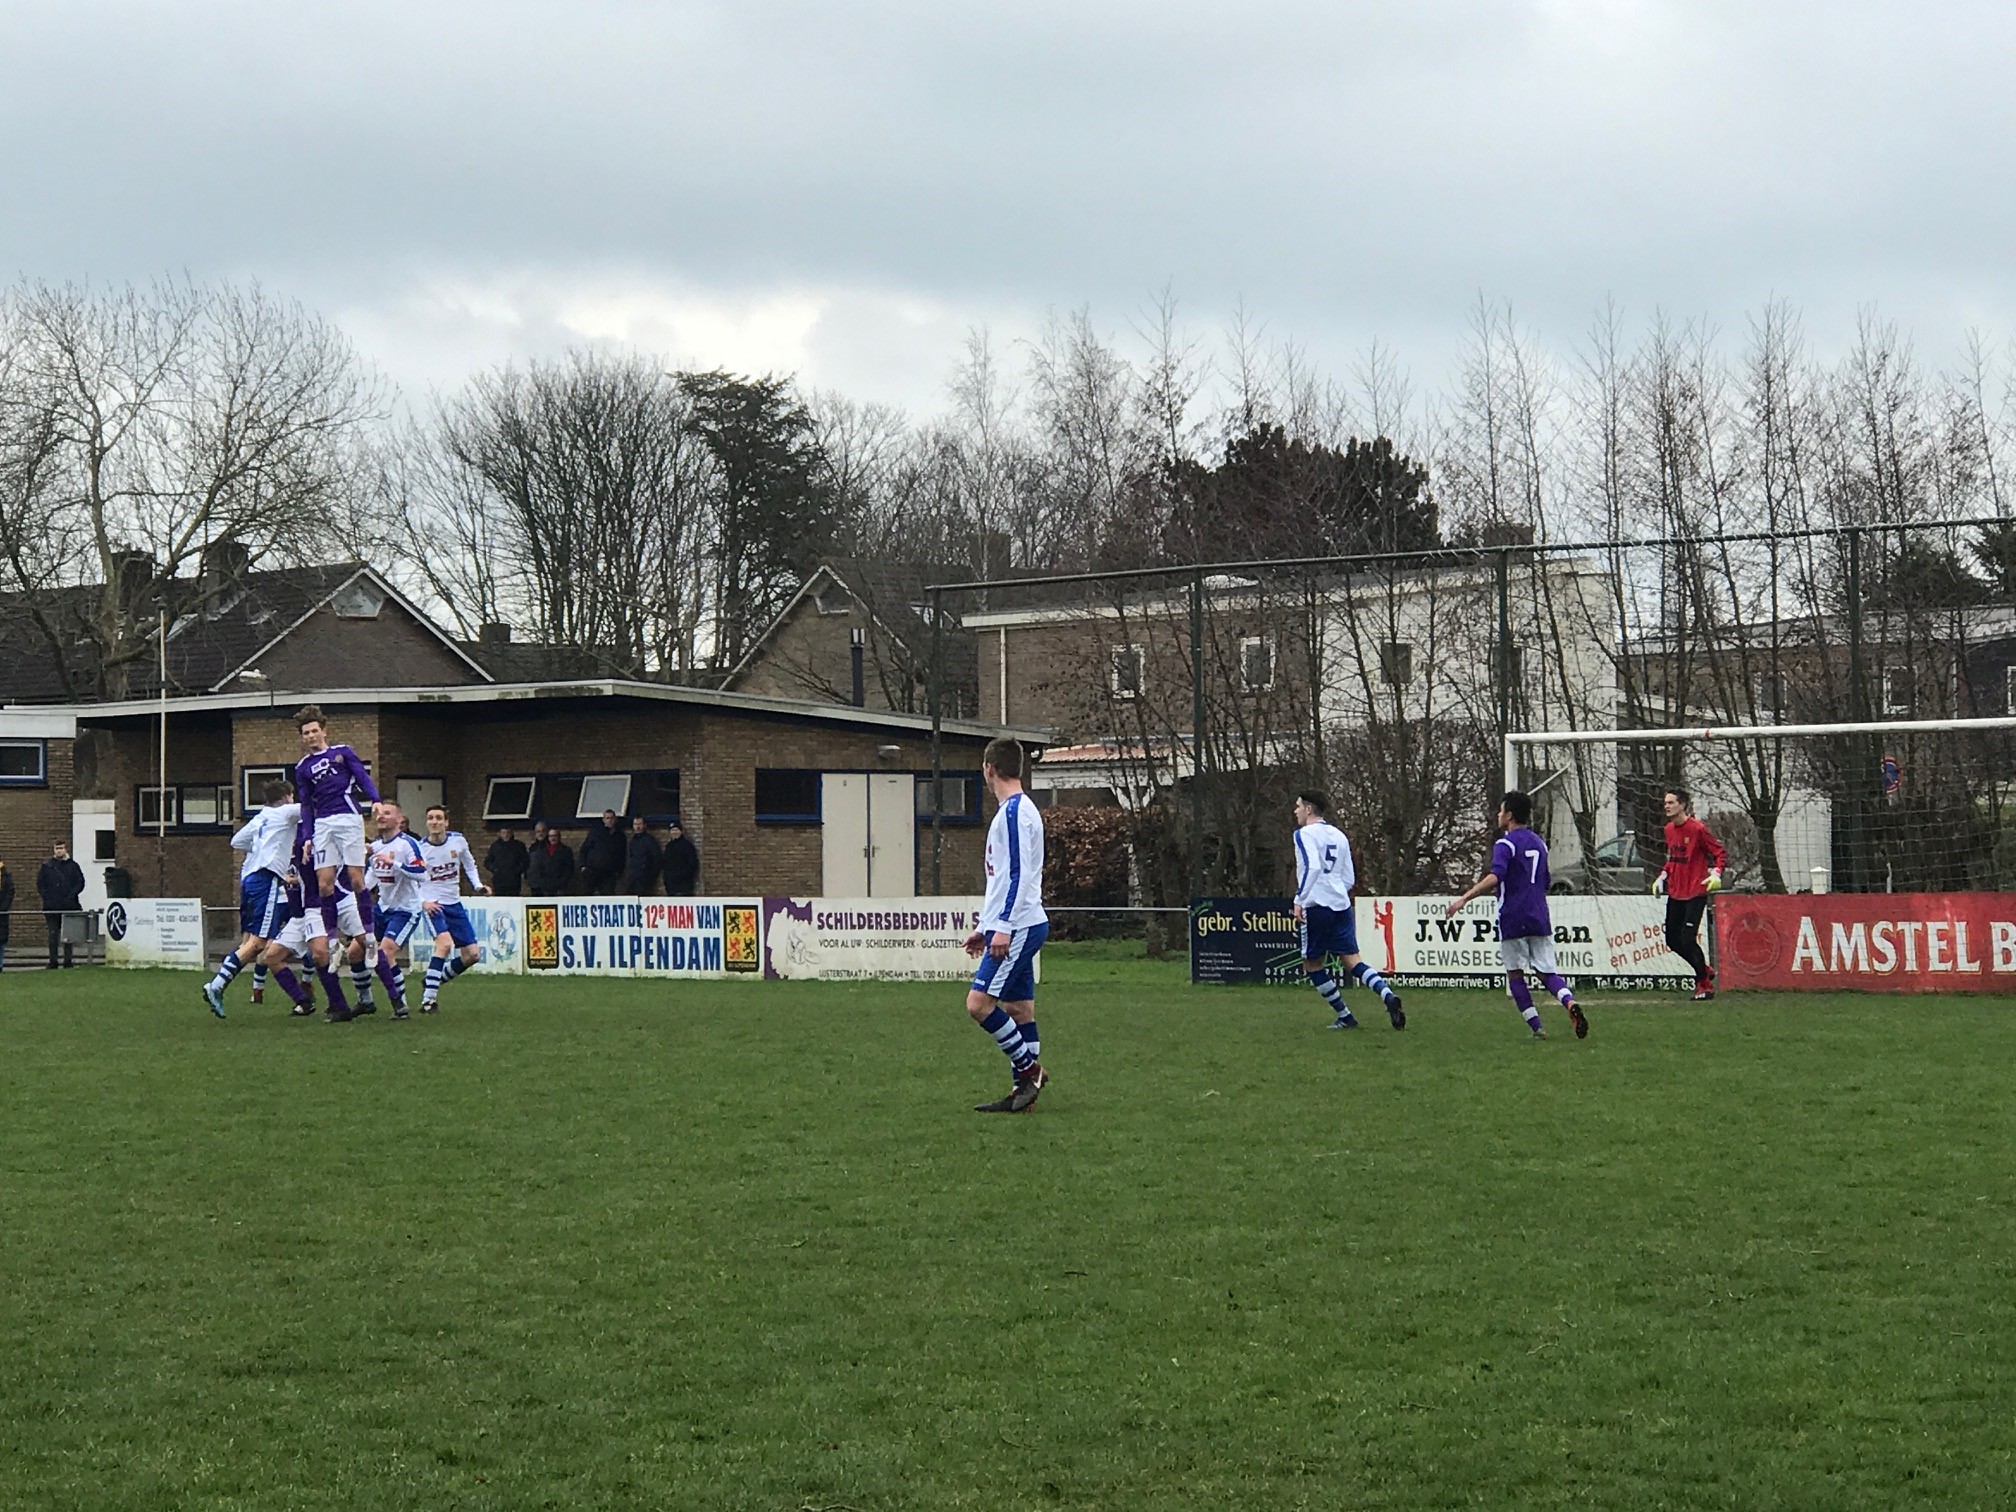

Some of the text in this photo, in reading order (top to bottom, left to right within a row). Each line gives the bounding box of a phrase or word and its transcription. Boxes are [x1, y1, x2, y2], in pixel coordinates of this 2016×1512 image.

[1323, 844, 1338, 874] 5
[1524, 849, 1540, 884] 7
[562, 904, 588, 928] HIER
[590, 904, 625, 928] STAAT
[627, 904, 643, 928] DE
[667, 905, 694, 929] MAN
[696, 905, 720, 929] VAN
[1417, 901, 1496, 918] loonedrijf
[817, 911, 947, 931] SCHILDERSBEDRIJF
[1198, 911, 1237, 937] gebr.
[819, 939, 840, 949] VOOR
[840, 939, 849, 948] AL
[866, 939, 916, 948] SCHILDERWERK
[1606, 931, 1637, 949] voor
[1791, 916, 1982, 975] AMSTEL
[562, 934, 721, 971] S.V. ILPENDAM
[1610, 953, 1628, 968] en
[1614, 977, 1654, 990] 06-105
[1658, 977, 1677, 990] 123
[1681, 977, 1696, 990] 63
